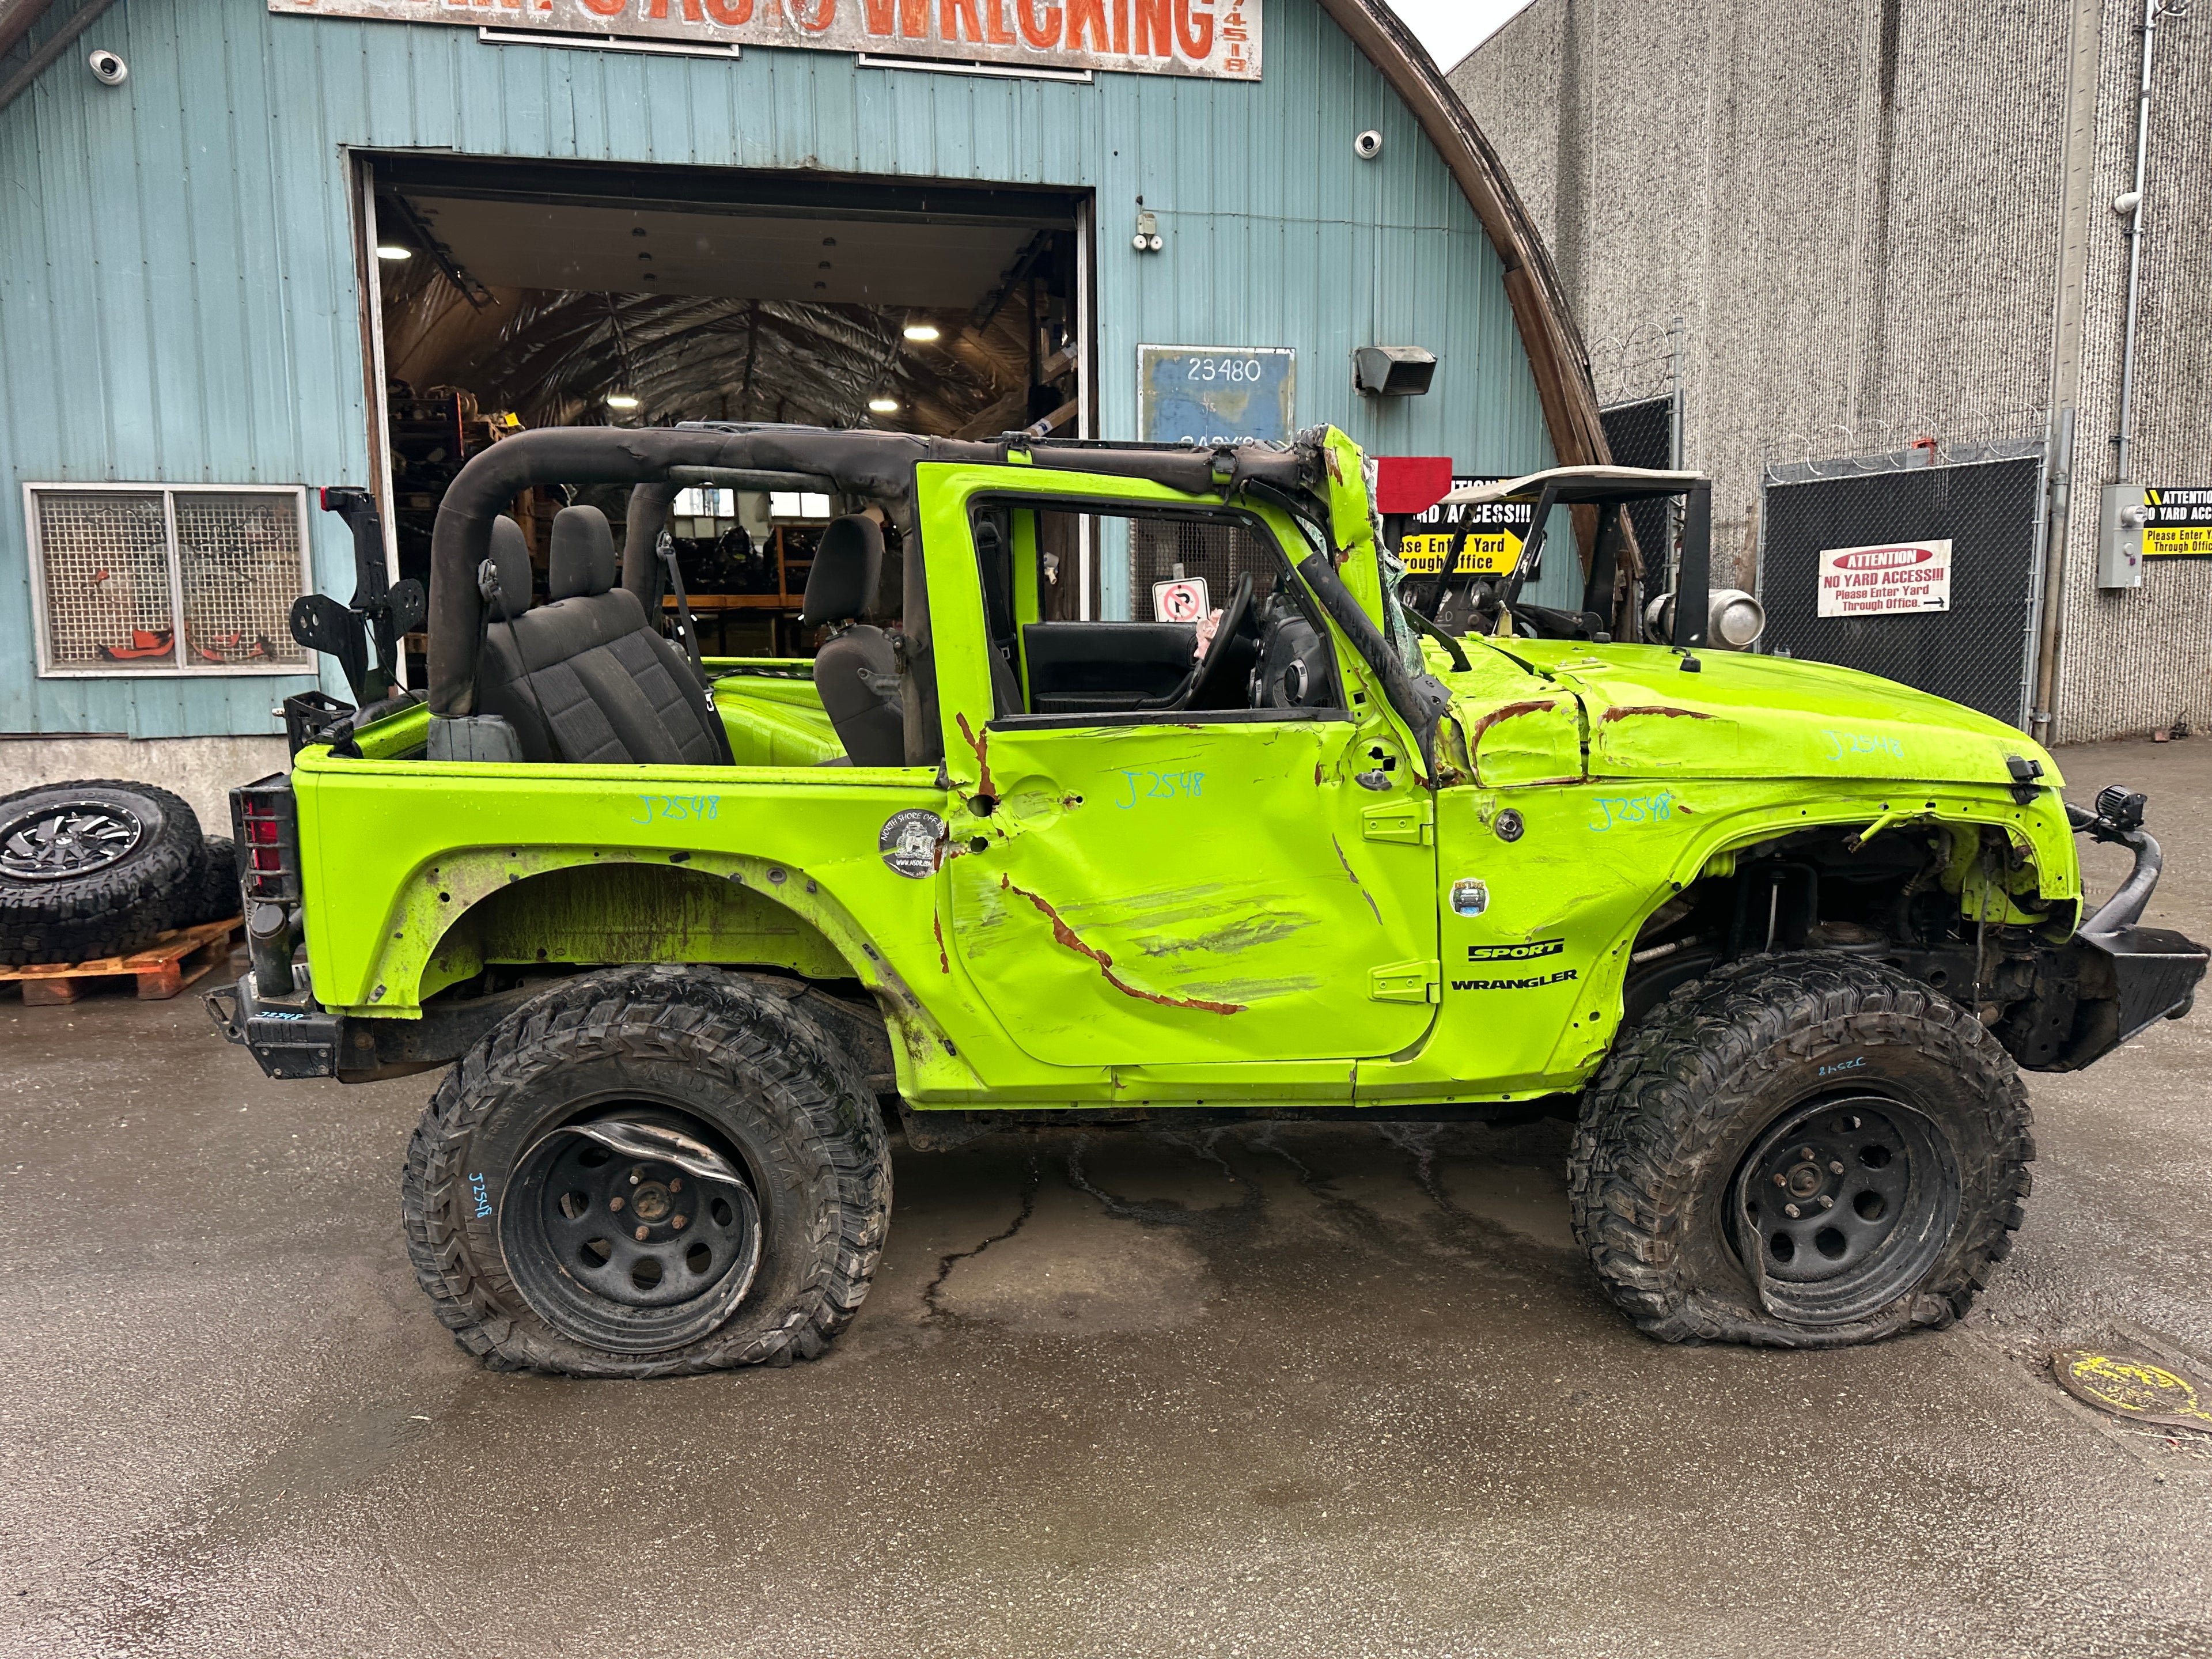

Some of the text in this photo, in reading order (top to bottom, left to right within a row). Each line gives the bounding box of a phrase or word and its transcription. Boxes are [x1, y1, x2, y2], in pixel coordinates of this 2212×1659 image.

[1187, 357, 1261, 381] 23480
[1413, 504, 1439, 523] RD
[2147, 507, 2156, 520] O
[2160, 507, 2187, 520] YARD
[2147, 530, 2176, 541] Please
[2180, 529, 2203, 540] Enter
[1429, 537, 1467, 553] Entr
[1474, 537, 1505, 552] Yard
[2154, 541, 2188, 553] Through
[1847, 550, 1917, 569] ATTENTION
[1824, 567, 1944, 589] NO YARD ACCESS!!!
[1835, 584, 1929, 600] Please Enter Yard
[1843, 599, 1883, 611] Through
[1820, 729, 1904, 761] J2548
[1115, 770, 1206, 809] J2548
[631, 794, 721, 825] J2548
[1588, 793, 1672, 832] J2548
[881, 819, 898, 841] NORTH
[897, 812, 922, 823] SHORE
[1469, 940, 1564, 959] SPORT
[1450, 969, 1579, 990] WRANGLER
[255, 1011, 304, 1020] J2548
[1818, 1056, 1866, 1076] J2548
[468, 1172, 493, 1218] J2548
